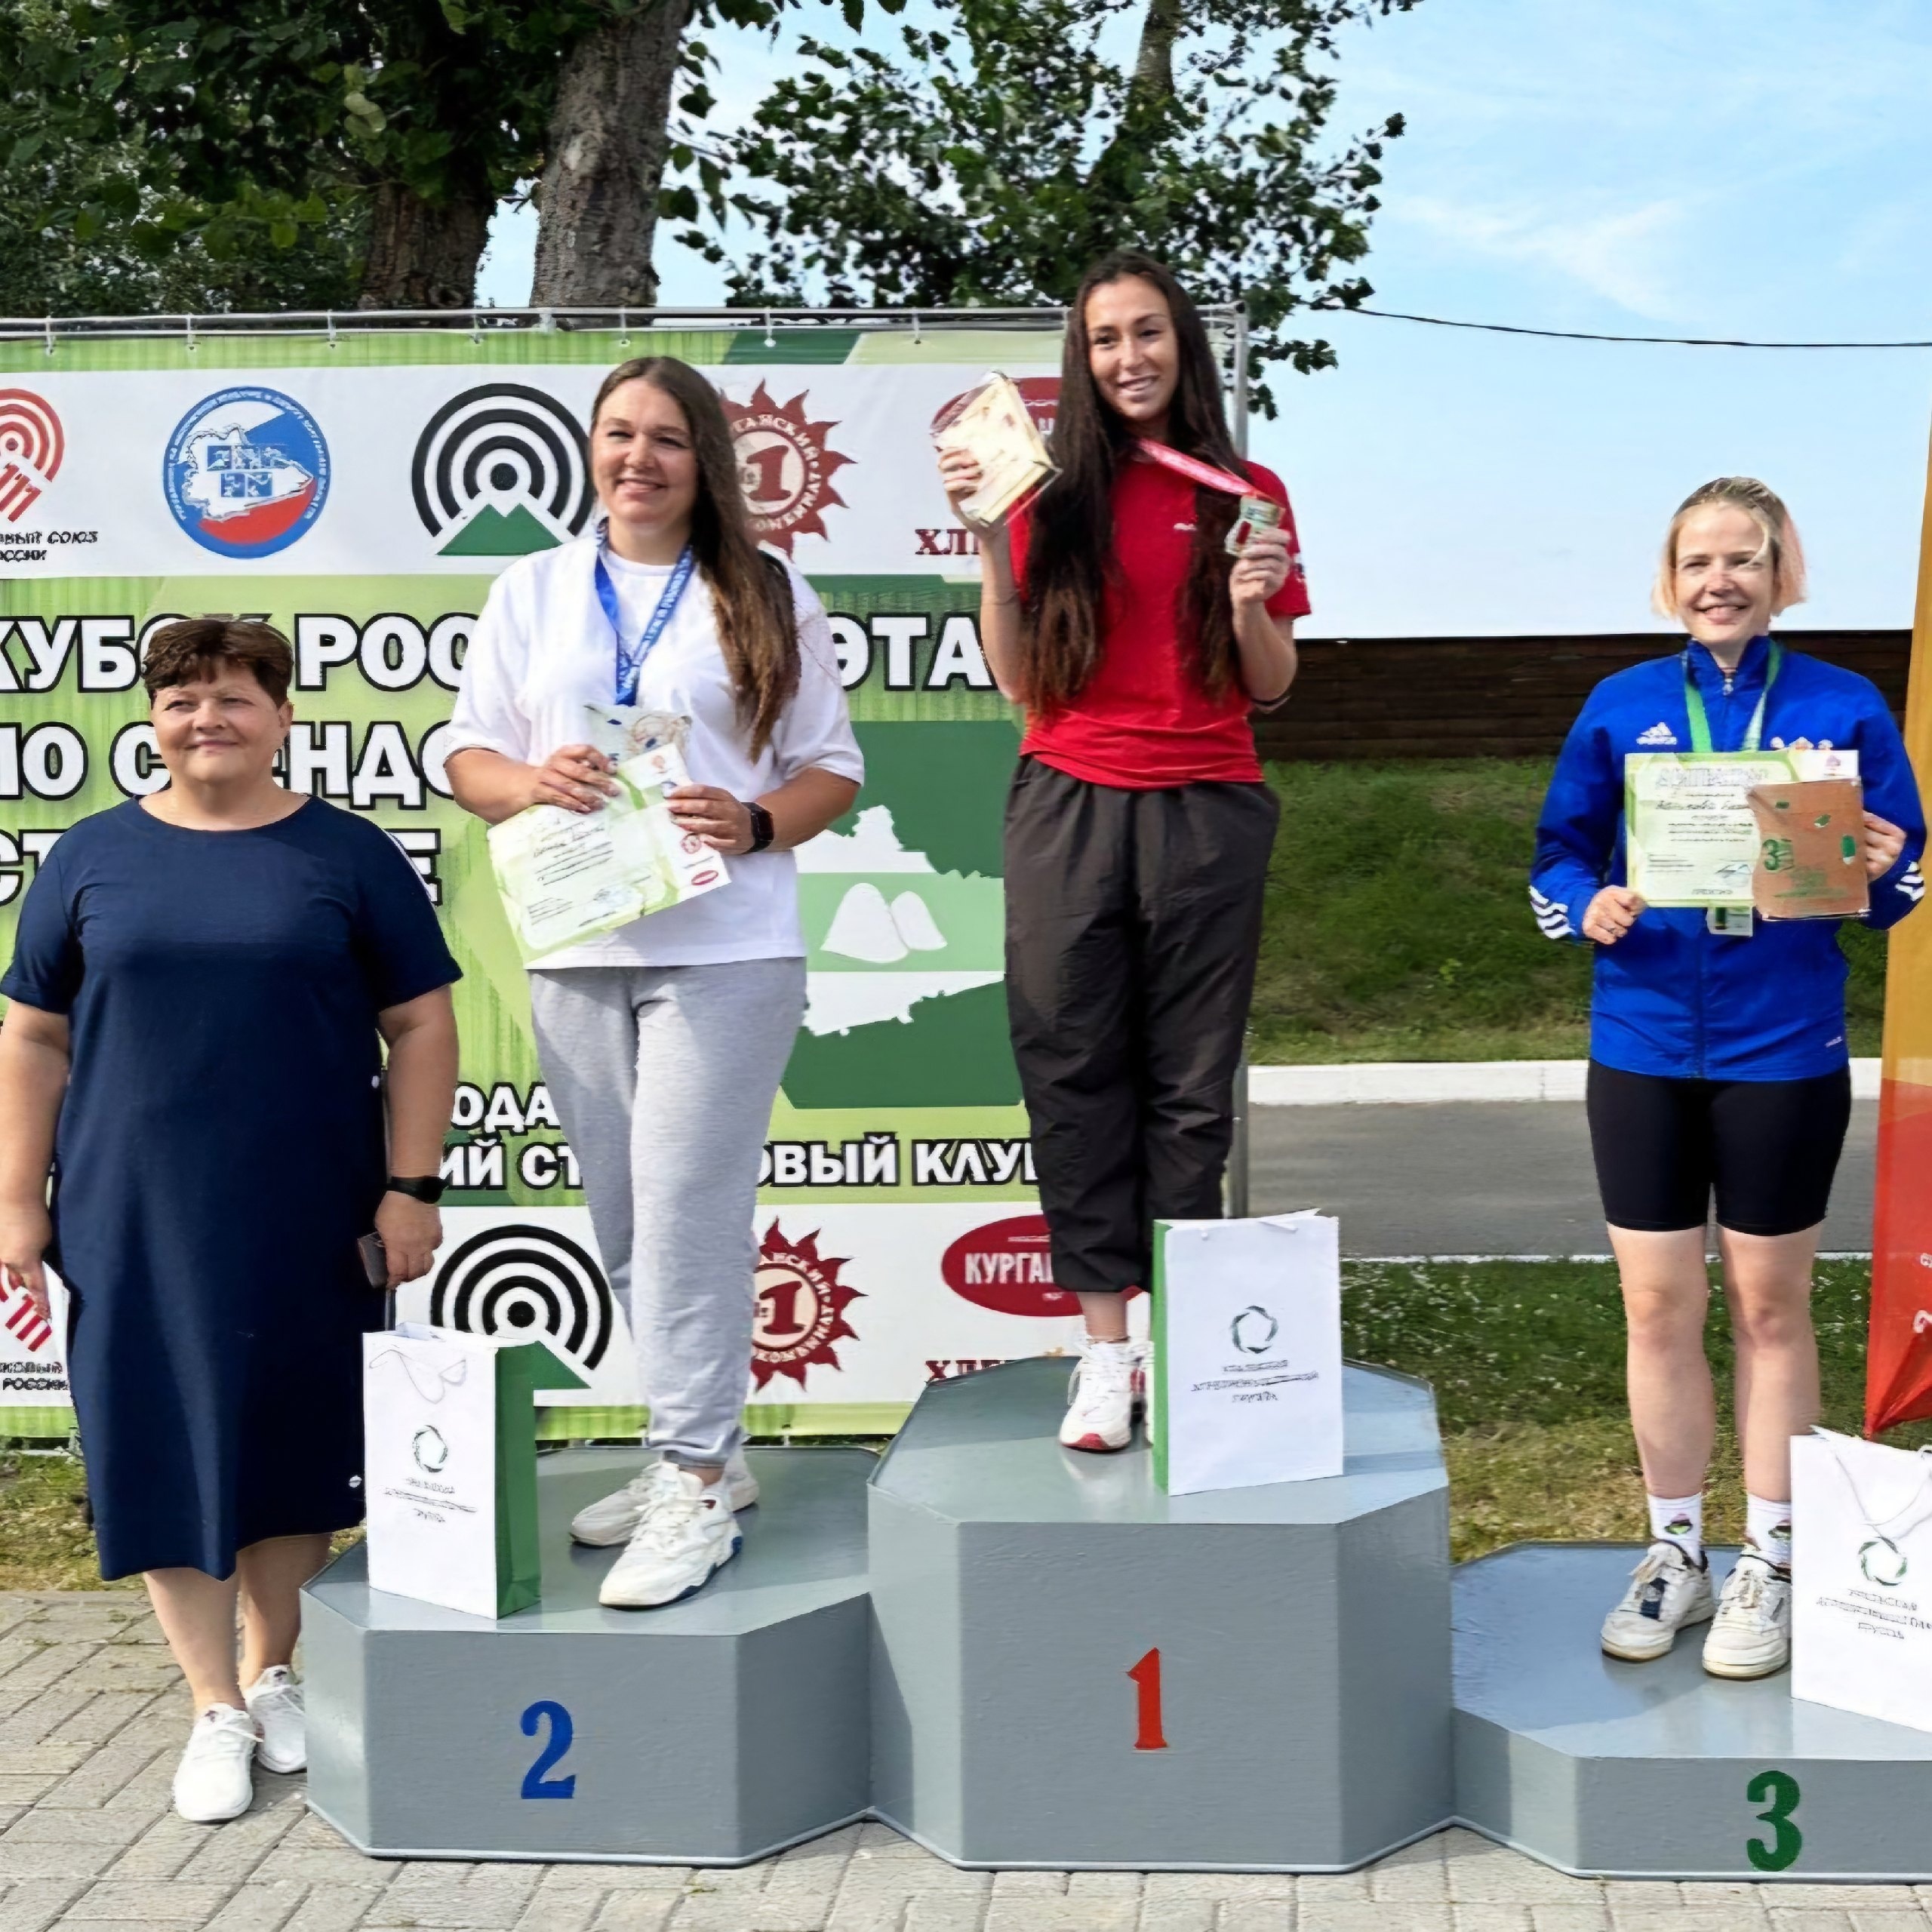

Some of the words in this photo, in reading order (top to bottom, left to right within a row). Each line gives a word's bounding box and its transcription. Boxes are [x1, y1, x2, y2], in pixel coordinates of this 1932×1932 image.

[294, 612, 479, 692] РОС
[826, 612, 998, 691] ЭТА
[451, 1081, 561, 1136] ОДА
[521, 1700, 576, 1799] 2
[1125, 1647, 1169, 1753] 1
[1747, 1770, 1802, 1872] 3
